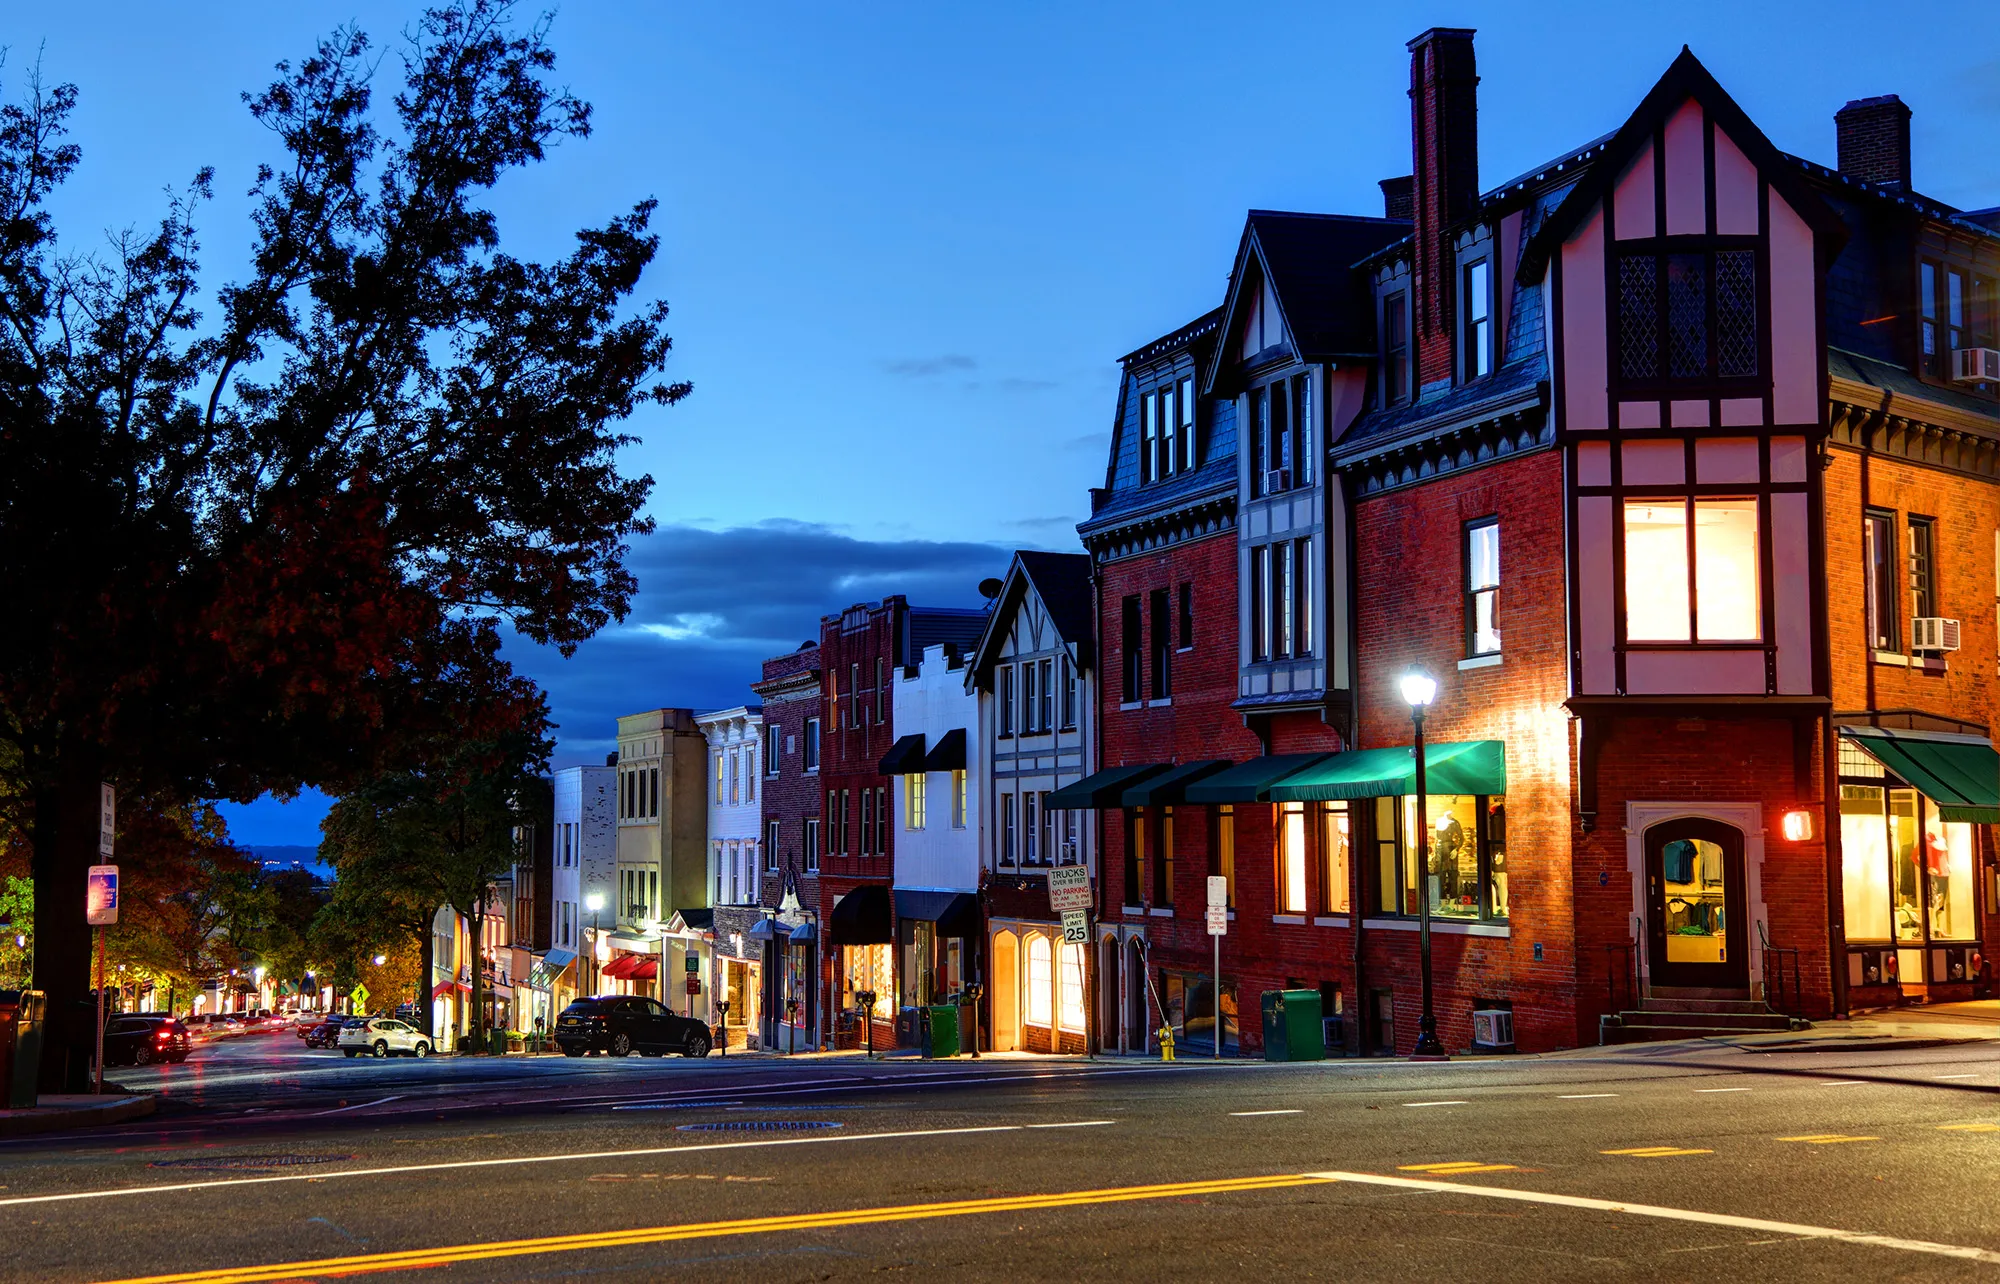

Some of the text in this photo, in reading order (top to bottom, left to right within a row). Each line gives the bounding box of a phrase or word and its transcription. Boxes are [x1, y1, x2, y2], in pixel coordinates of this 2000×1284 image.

[1051, 868, 1085, 879] TRUCKS
[1063, 886, 1088, 894] PARKING
[1064, 912, 1084, 920] SPEED
[1066, 927, 1085, 940] 25
